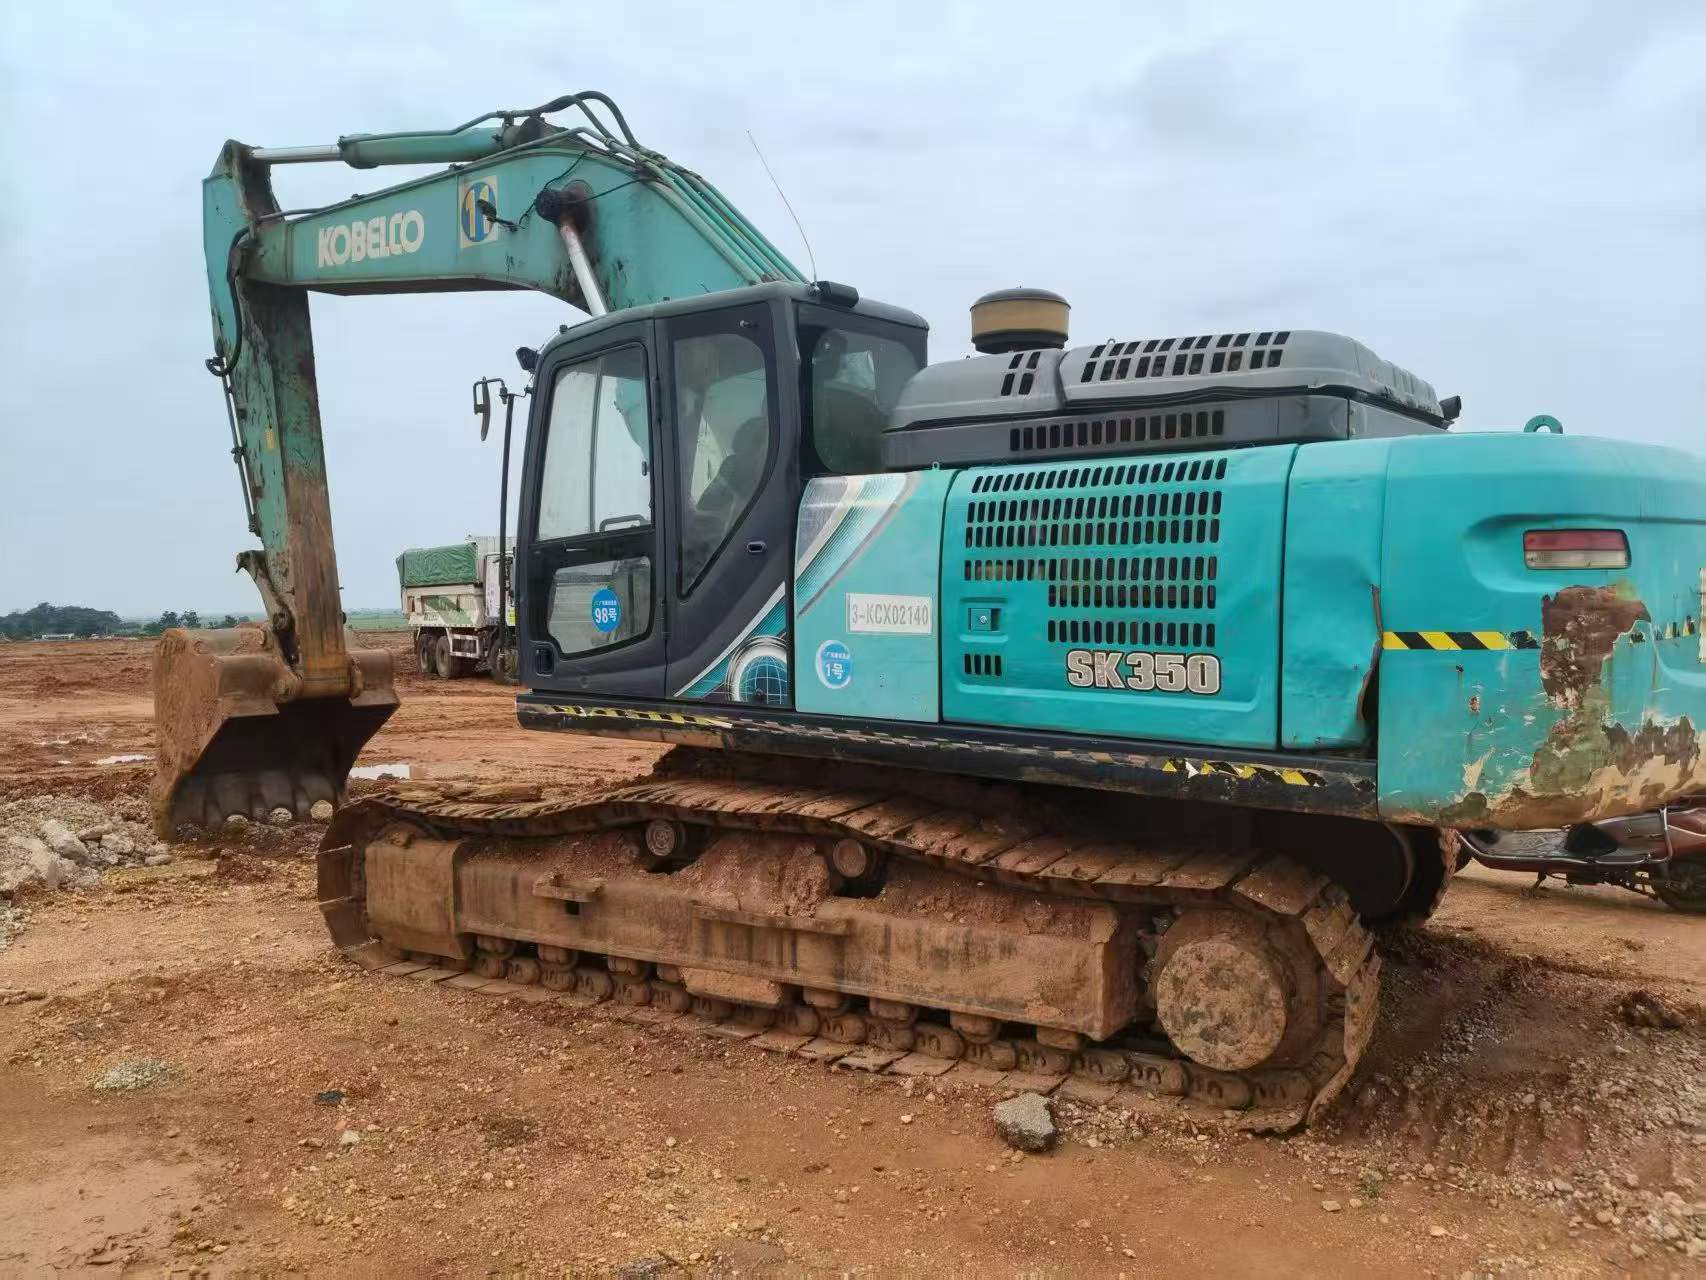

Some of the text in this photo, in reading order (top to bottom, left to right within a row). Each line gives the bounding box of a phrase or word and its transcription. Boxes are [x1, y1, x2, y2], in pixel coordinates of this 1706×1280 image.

[318, 210, 424, 268] KOBELCO
[595, 607, 617, 624] 98号
[852, 602, 930, 626] 3-KCX02140
[825, 662, 844, 680] 1号
[1066, 649, 1222, 696] SK350
